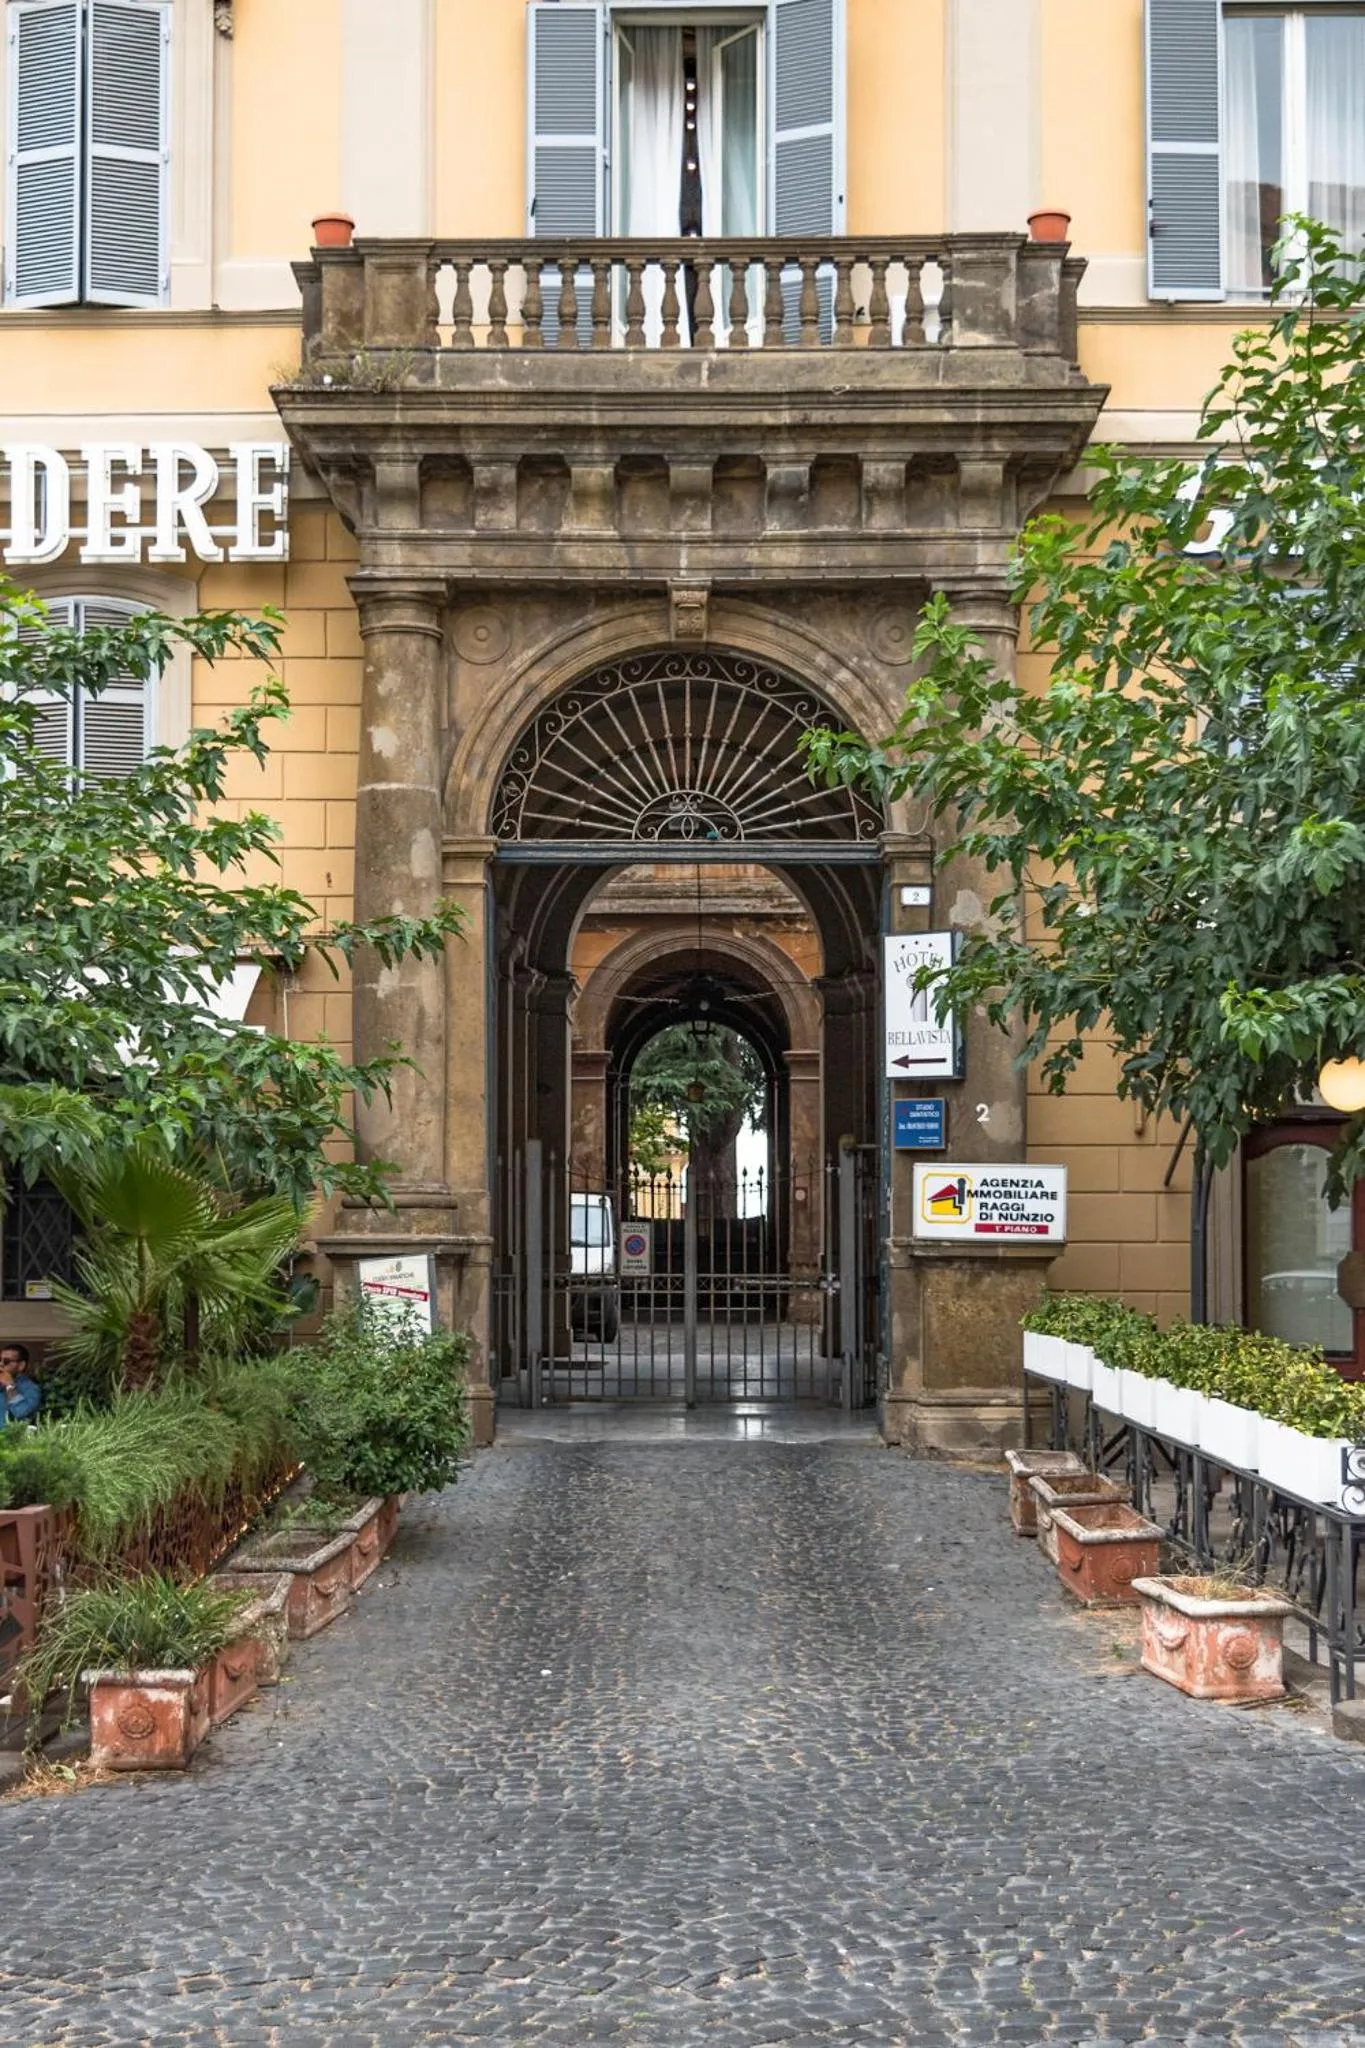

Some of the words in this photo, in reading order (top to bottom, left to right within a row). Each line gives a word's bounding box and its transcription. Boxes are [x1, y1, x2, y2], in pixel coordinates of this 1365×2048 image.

[3, 441, 291, 563] DERE
[888, 1030, 952, 1046] BELLAVISTA
[976, 1103, 990, 1122] 2
[980, 1178, 1045, 1189] AGENZIA
[979, 1202, 1025, 1211] RAGGI
[979, 1212, 993, 1221] DI
[998, 1212, 1055, 1223] NUNZIO
[1004, 1224, 1037, 1234] PIANO
